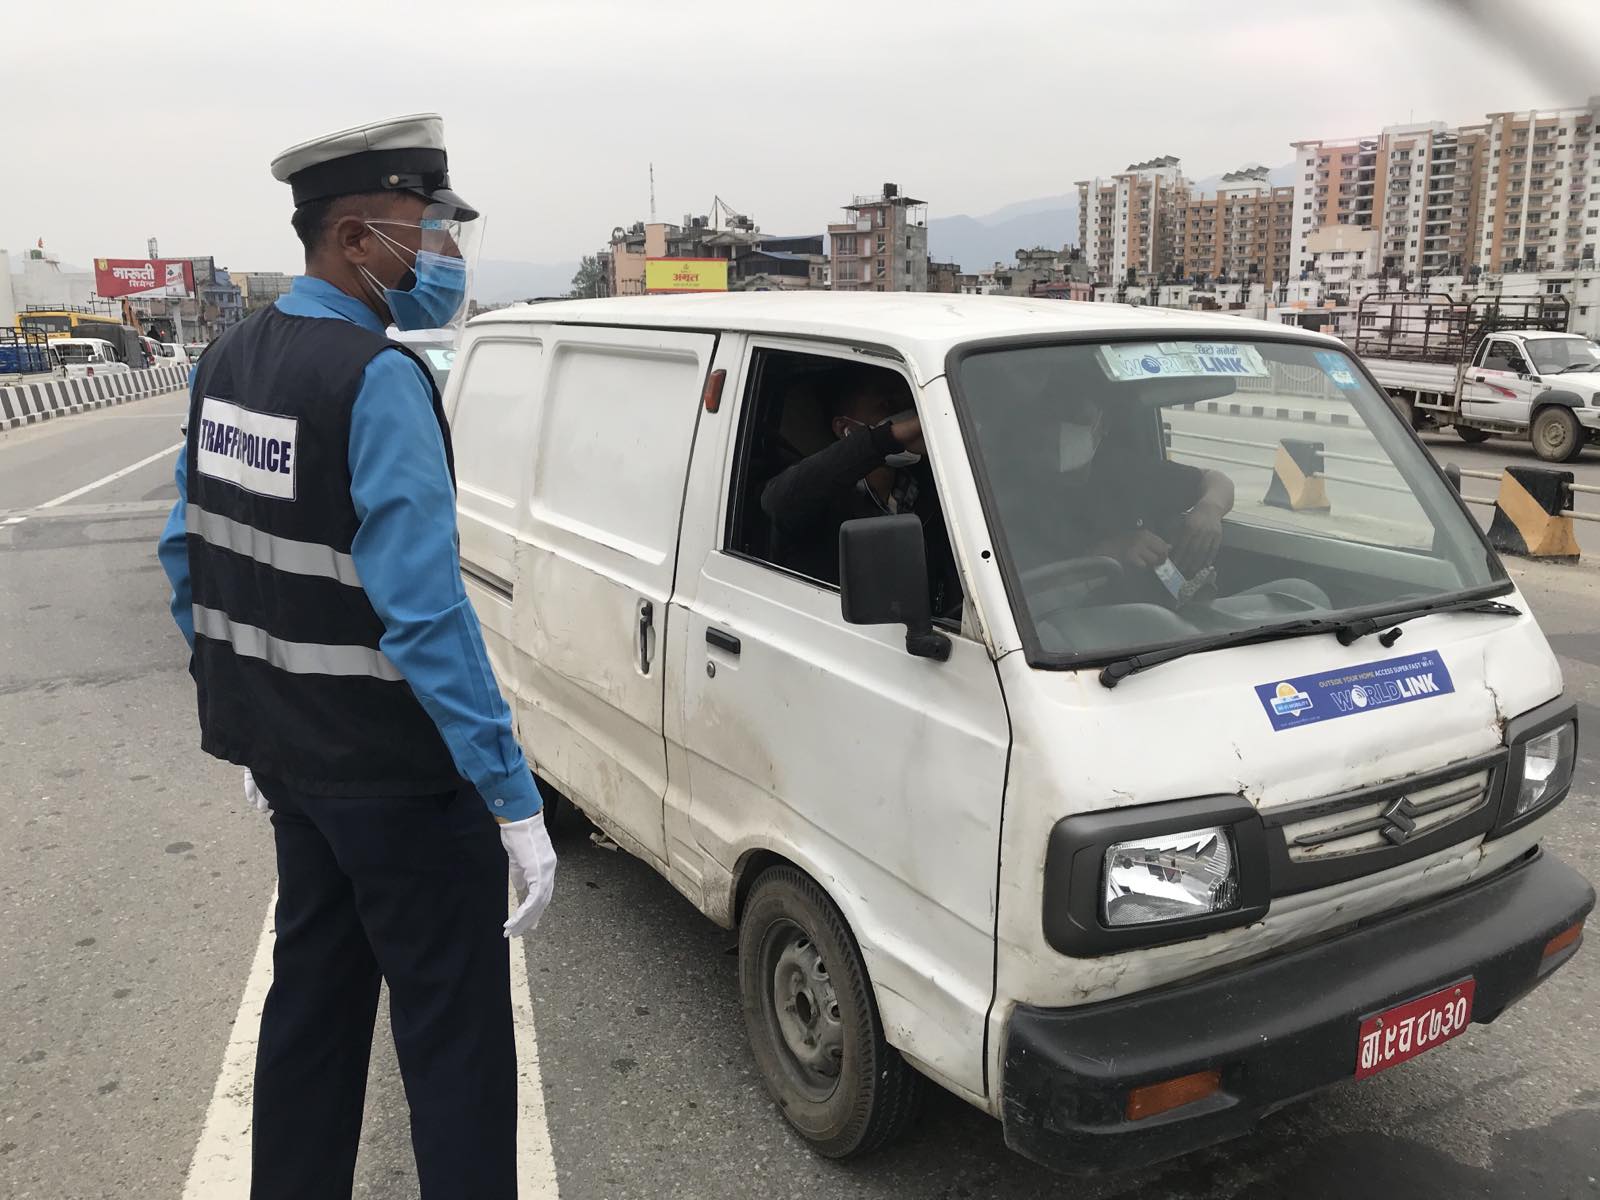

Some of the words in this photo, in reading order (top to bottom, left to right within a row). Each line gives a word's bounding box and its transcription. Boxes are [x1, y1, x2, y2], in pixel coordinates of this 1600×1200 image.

[1121, 355, 1249, 377] WORLDLINK
[201, 419, 242, 461] TRAFFI
[242, 432, 291, 474] POLICE
[1318, 678, 1343, 688] OUTSIDE
[1343, 674, 1359, 683] YOUR
[1359, 671, 1375, 680] HOME
[1375, 667, 1394, 677] ACCESS
[1393, 664, 1409, 673] SUPER
[1409, 661, 1421, 671] FAST
[1330, 672, 1440, 712] WORLDLINK
